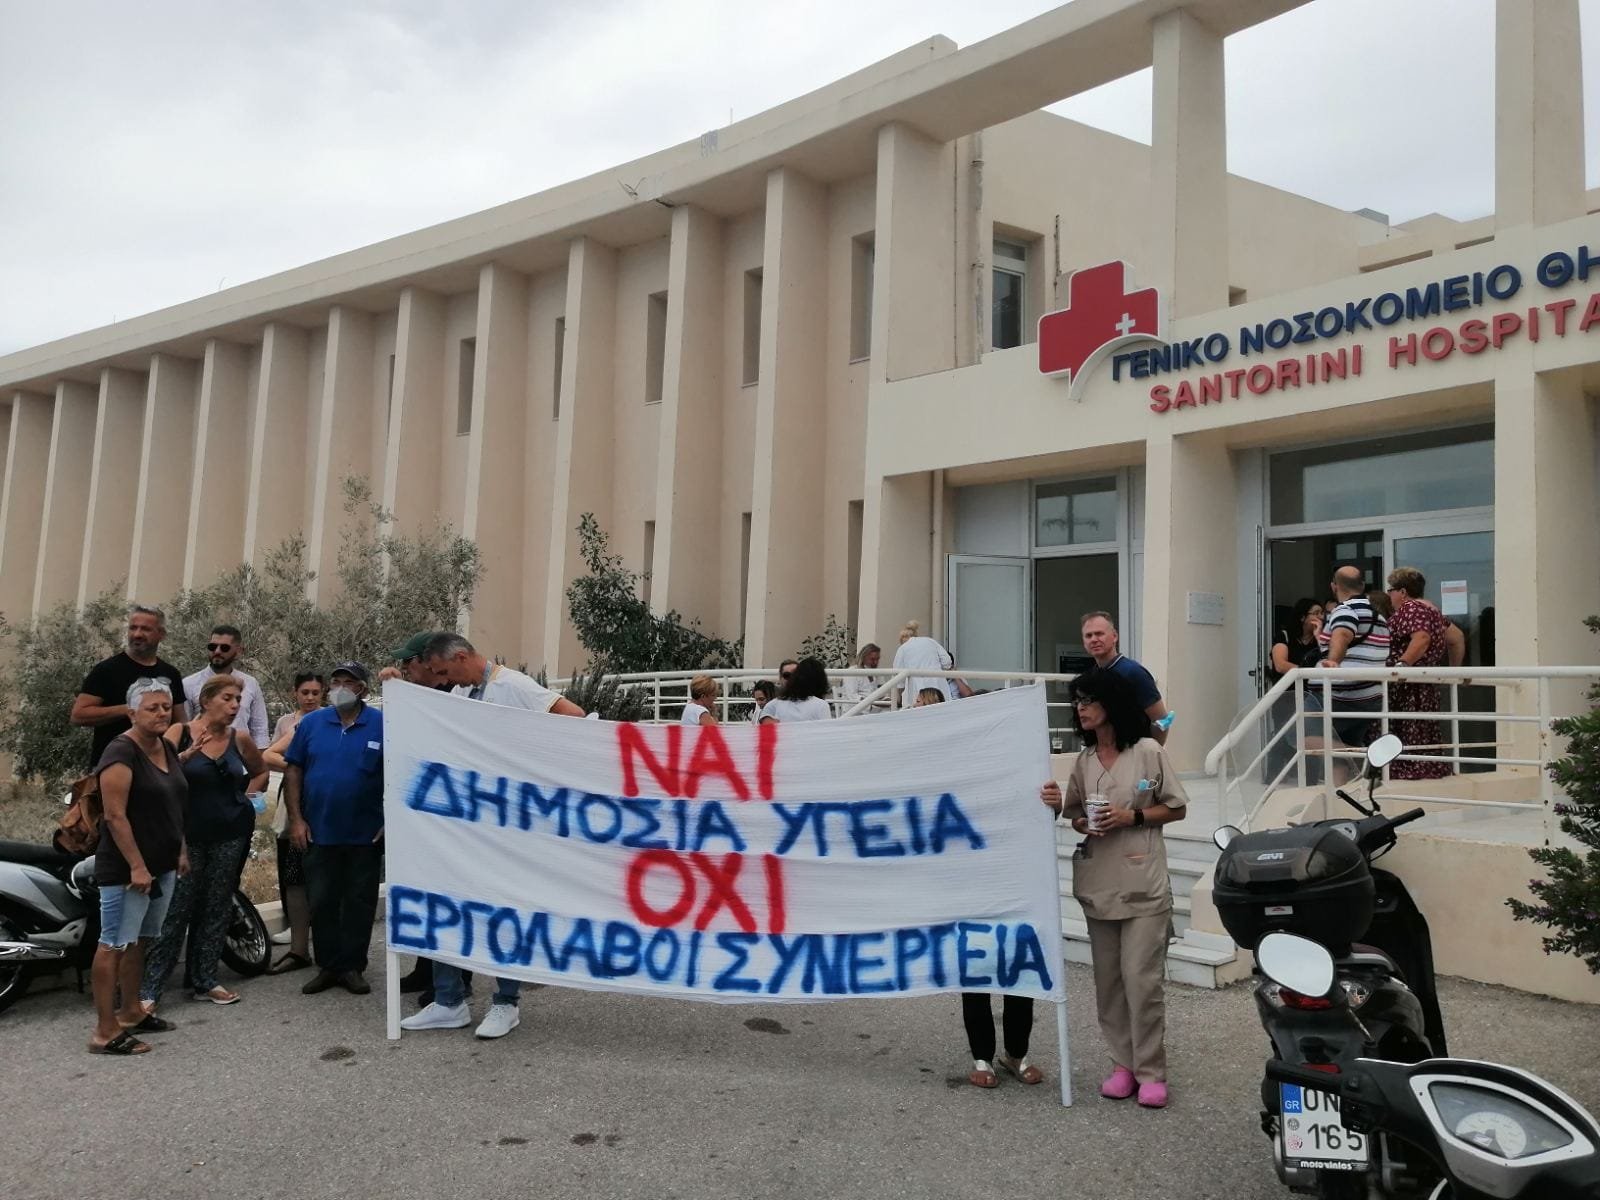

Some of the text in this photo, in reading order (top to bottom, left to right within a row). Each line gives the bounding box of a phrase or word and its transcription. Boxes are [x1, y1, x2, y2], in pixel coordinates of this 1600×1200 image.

[1113, 332, 1229, 382] ΓΕΝΙΚΟ
[1240, 264, 1522, 356] ΝΟΣΟΚΟΜΕΙΟ
[1150, 344, 1362, 413] SANTORINI
[616, 722, 777, 800] ΝΑΙ
[407, 761, 987, 858] ΔΗΜΟΣΙΑ ΥΓΕΙΑ
[626, 849, 786, 934] ΟΧΙ
[390, 885, 1054, 994] ΕΡΓΟΛΑΒΟΙ ΣΥΝΕΡΓΕΙΑ
[1284, 1100, 1300, 1110] GR
[1307, 1123, 1363, 1151] 165
